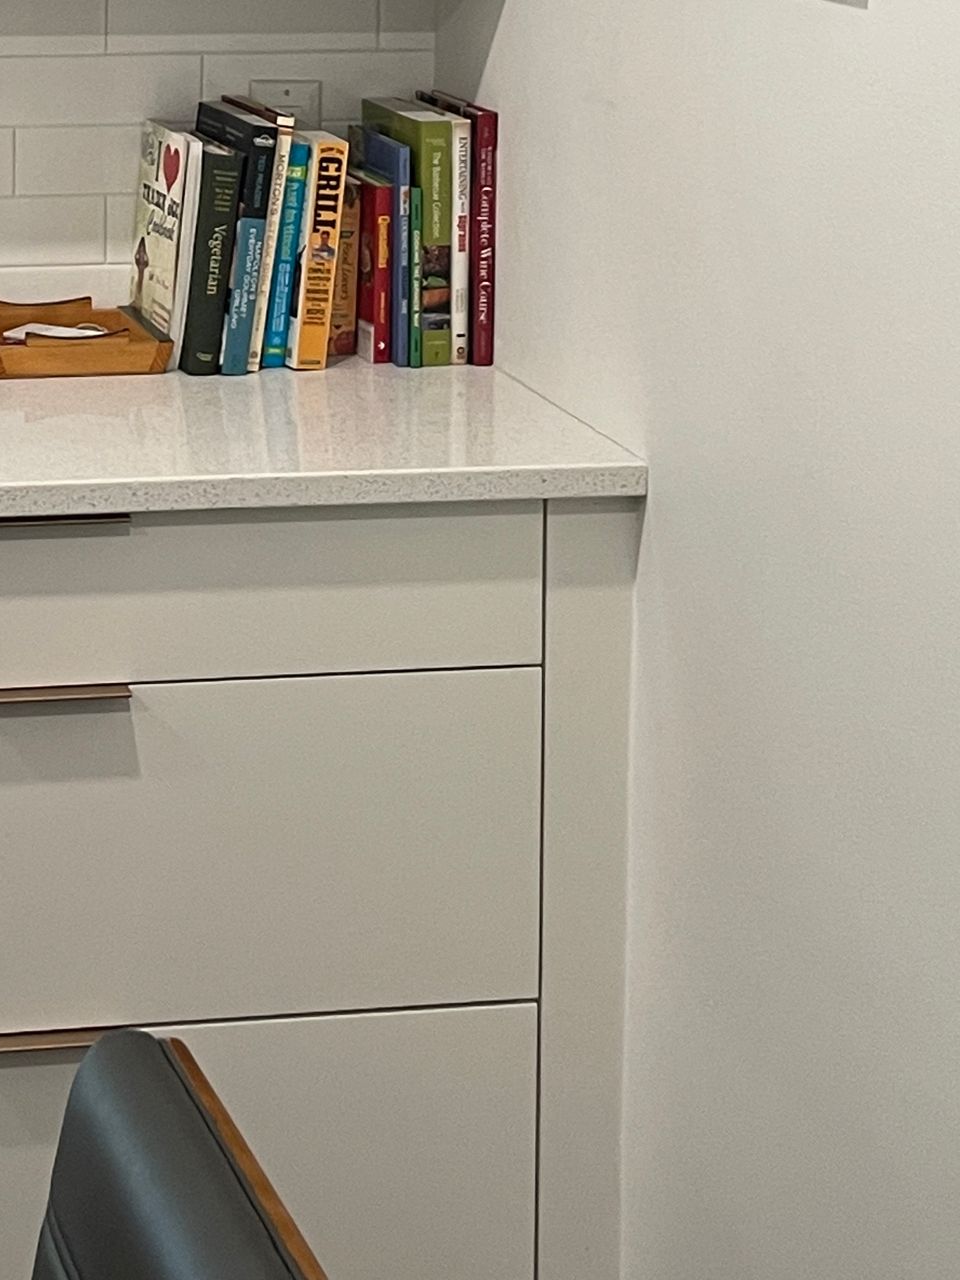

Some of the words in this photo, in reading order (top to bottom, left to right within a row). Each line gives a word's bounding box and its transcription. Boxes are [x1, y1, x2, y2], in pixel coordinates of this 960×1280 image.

[432, 152, 441, 164] The
[458, 136, 468, 200] ENTERTAINING
[313, 156, 343, 233] GRILL
[432, 166, 441, 201] Barbecue
[432, 202, 442, 239] Collection
[476, 187, 492, 246] Complete
[206, 224, 228, 296] Vegetarian
[243, 228, 257, 272] EVERYDAY
[479, 247, 491, 279] Wine
[230, 289, 242, 329] GRILLING
[240, 274, 252, 318] GOURMET
[478, 281, 492, 325] Course
